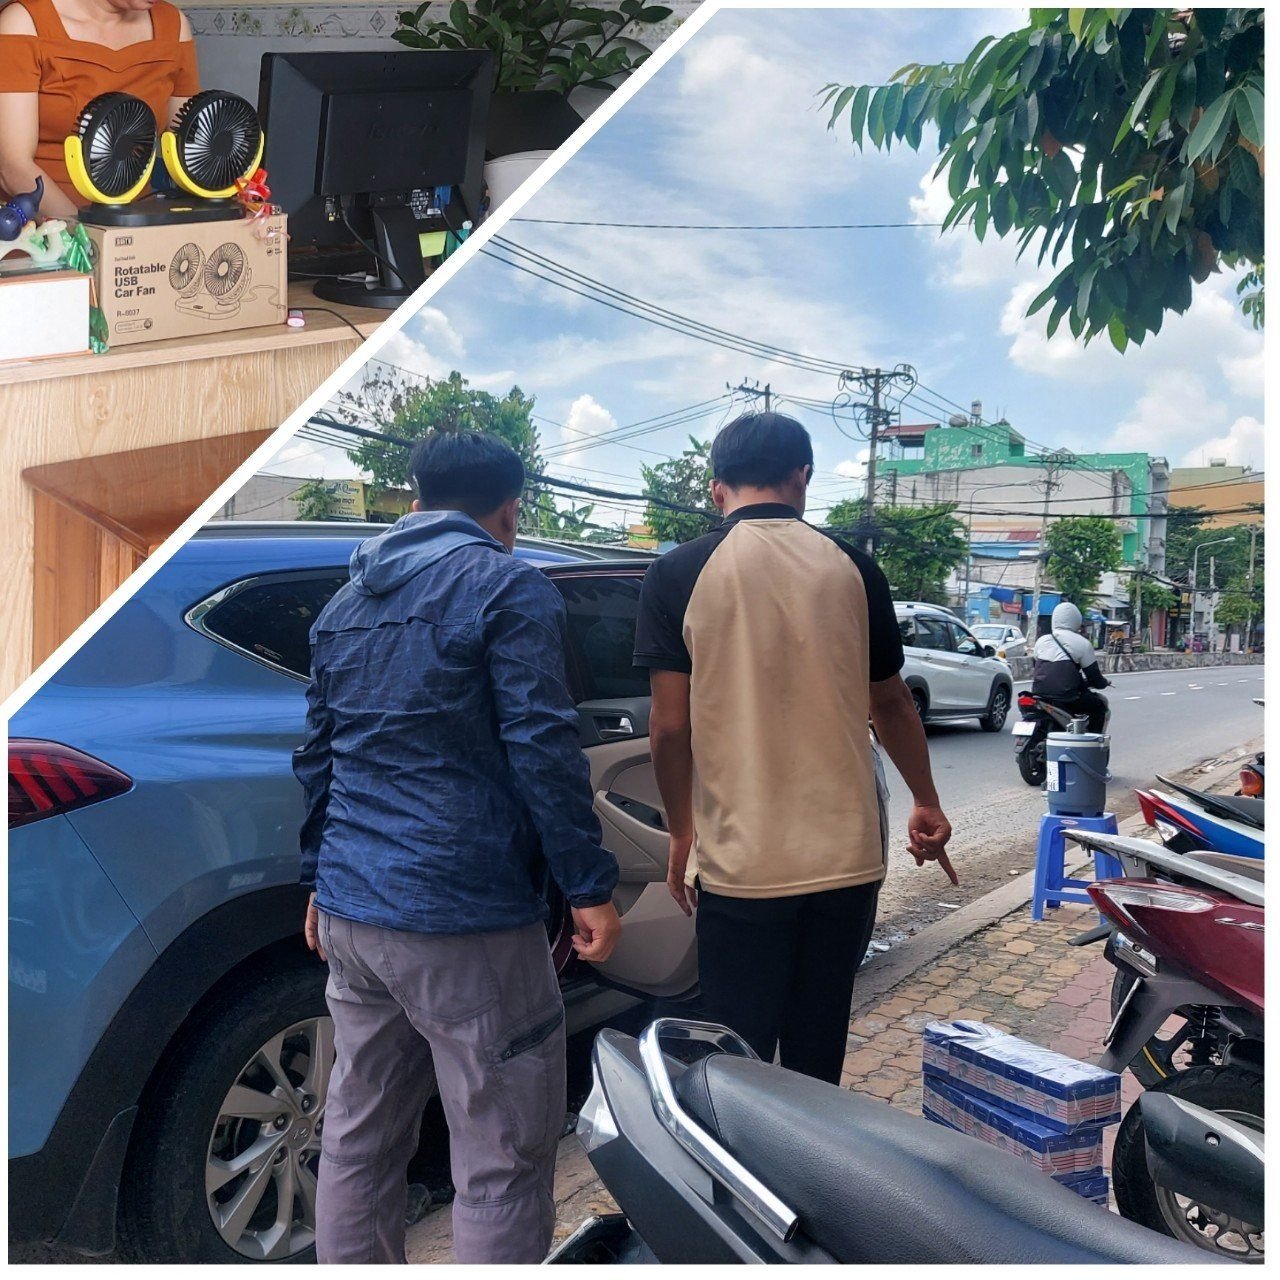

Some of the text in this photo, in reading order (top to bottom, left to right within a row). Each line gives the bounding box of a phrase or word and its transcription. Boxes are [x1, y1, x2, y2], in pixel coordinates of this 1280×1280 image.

[114, 263, 166, 277] Rotatable
[115, 276, 138, 287] USB
[114, 286, 156, 299] Car Fan
